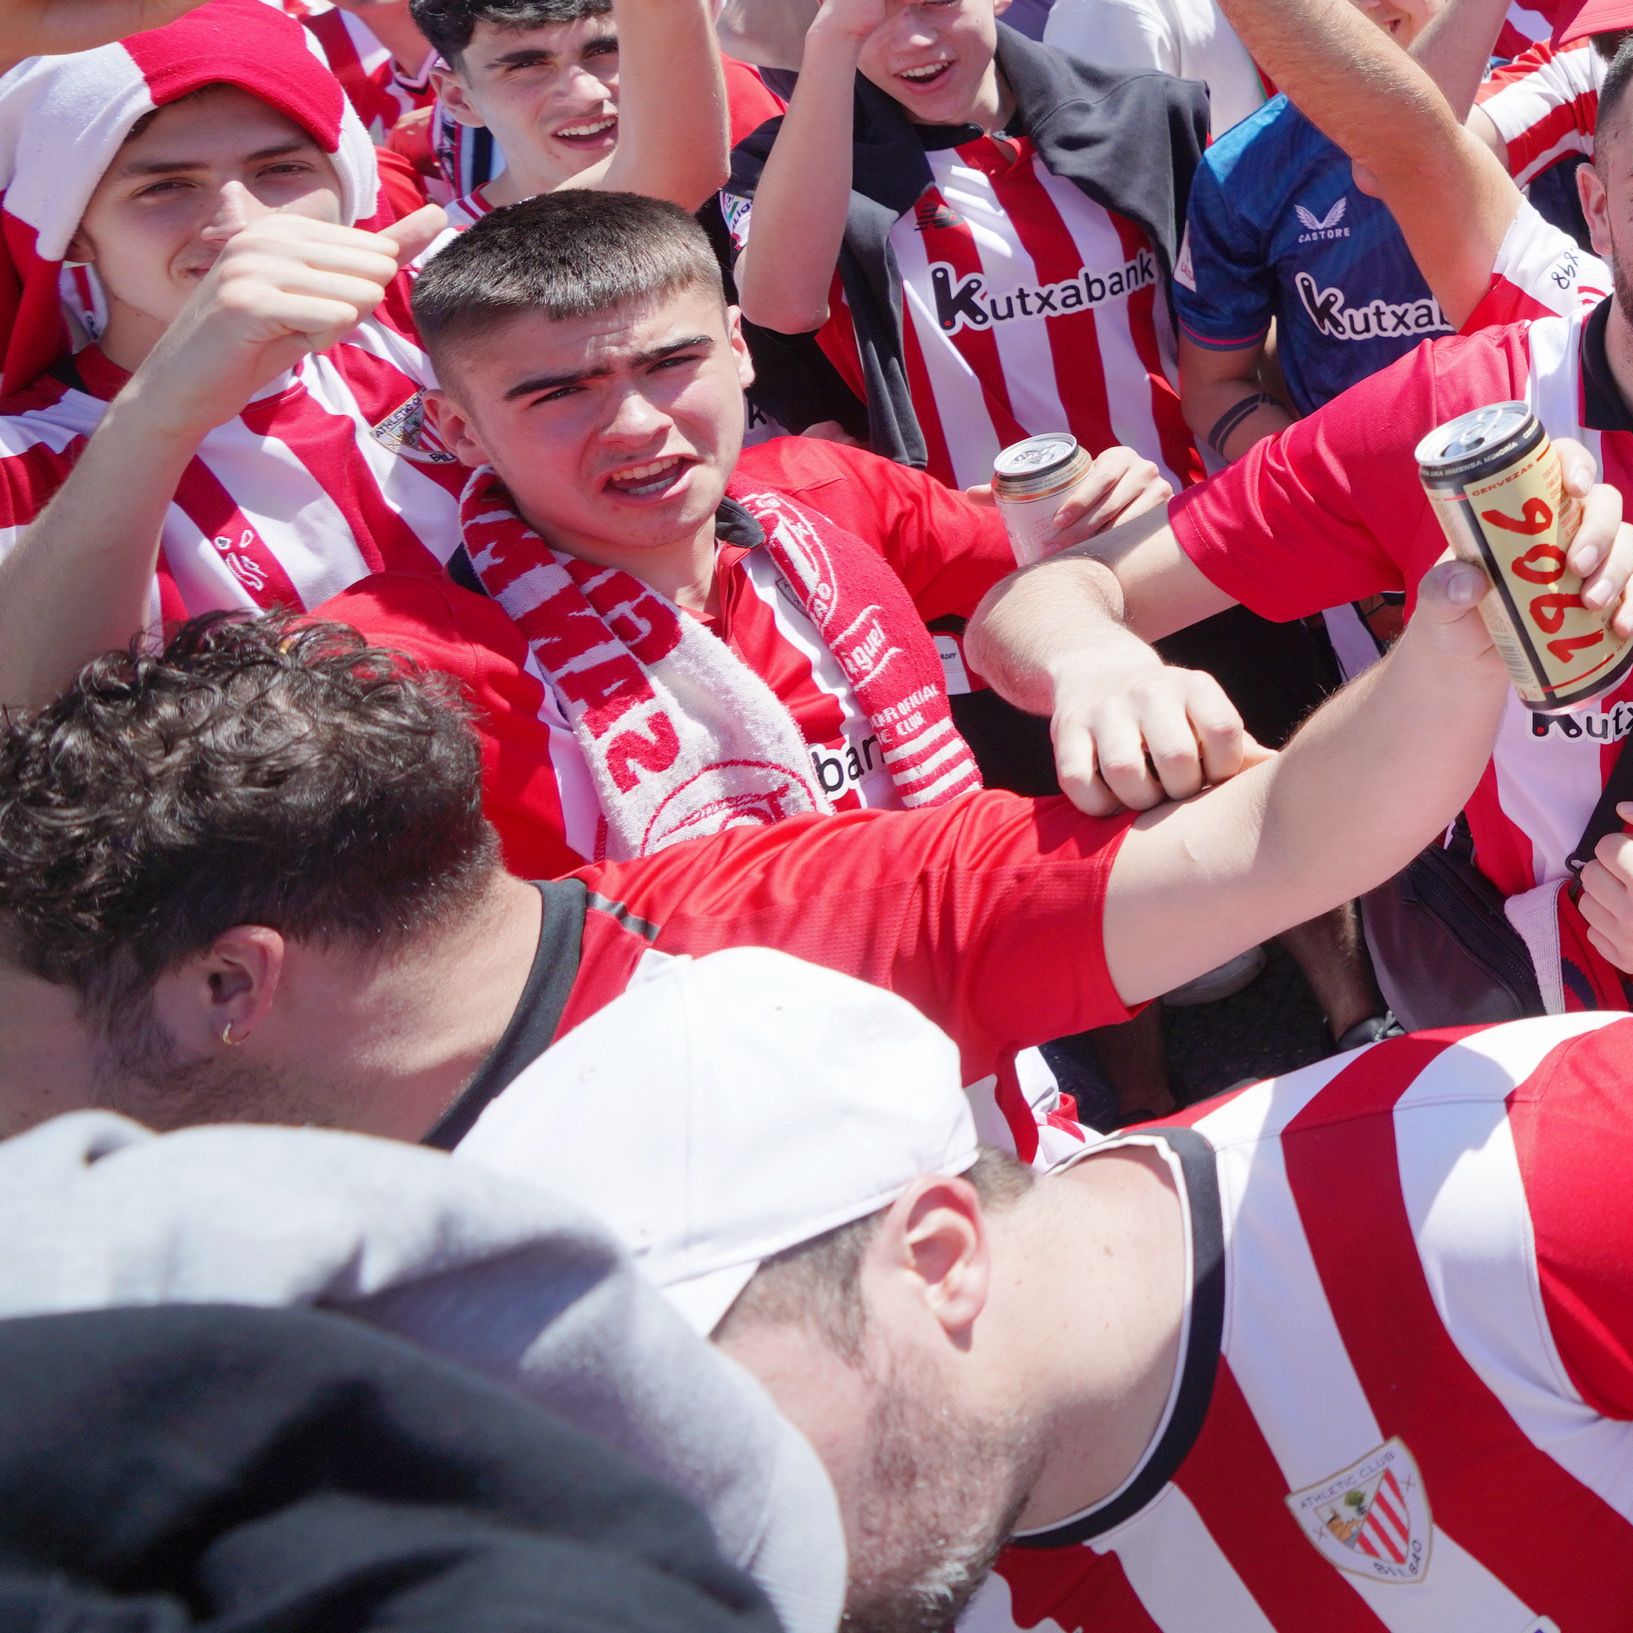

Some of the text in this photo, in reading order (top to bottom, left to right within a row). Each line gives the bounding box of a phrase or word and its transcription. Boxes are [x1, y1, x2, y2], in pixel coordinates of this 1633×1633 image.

[1298, 226, 1351, 243] CASTORE
[931, 250, 1155, 331] Kutxabank
[1299, 276, 1453, 336] Kutxa
[1471, 462, 1534, 497] CERVEZAS
[1480, 496, 1606, 664] 1906
[842, 618, 885, 674] iguel
[1299, 1468, 1358, 1512] ATHLETIC
